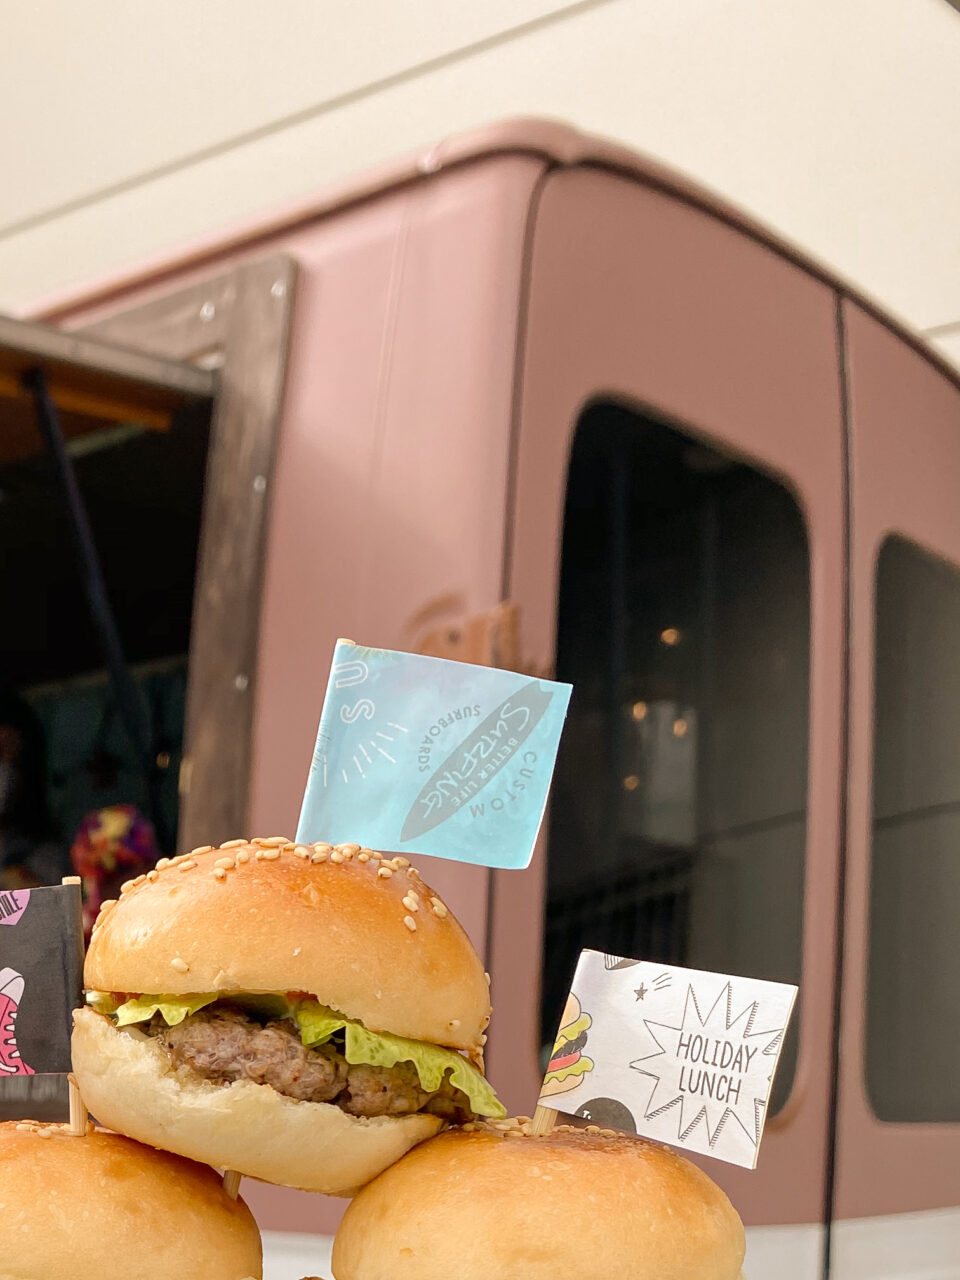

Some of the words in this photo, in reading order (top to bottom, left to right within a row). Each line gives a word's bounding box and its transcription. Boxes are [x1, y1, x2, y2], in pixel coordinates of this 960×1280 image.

[418, 704, 481, 773] SURFBOARDS
[477, 736, 519, 780] BETTER
[450, 780, 479, 807] LIFE
[469, 750, 538, 819] CUSTOM
[675, 1031, 758, 1074] HOLIDAY
[678, 1065, 742, 1106] LUNCH
